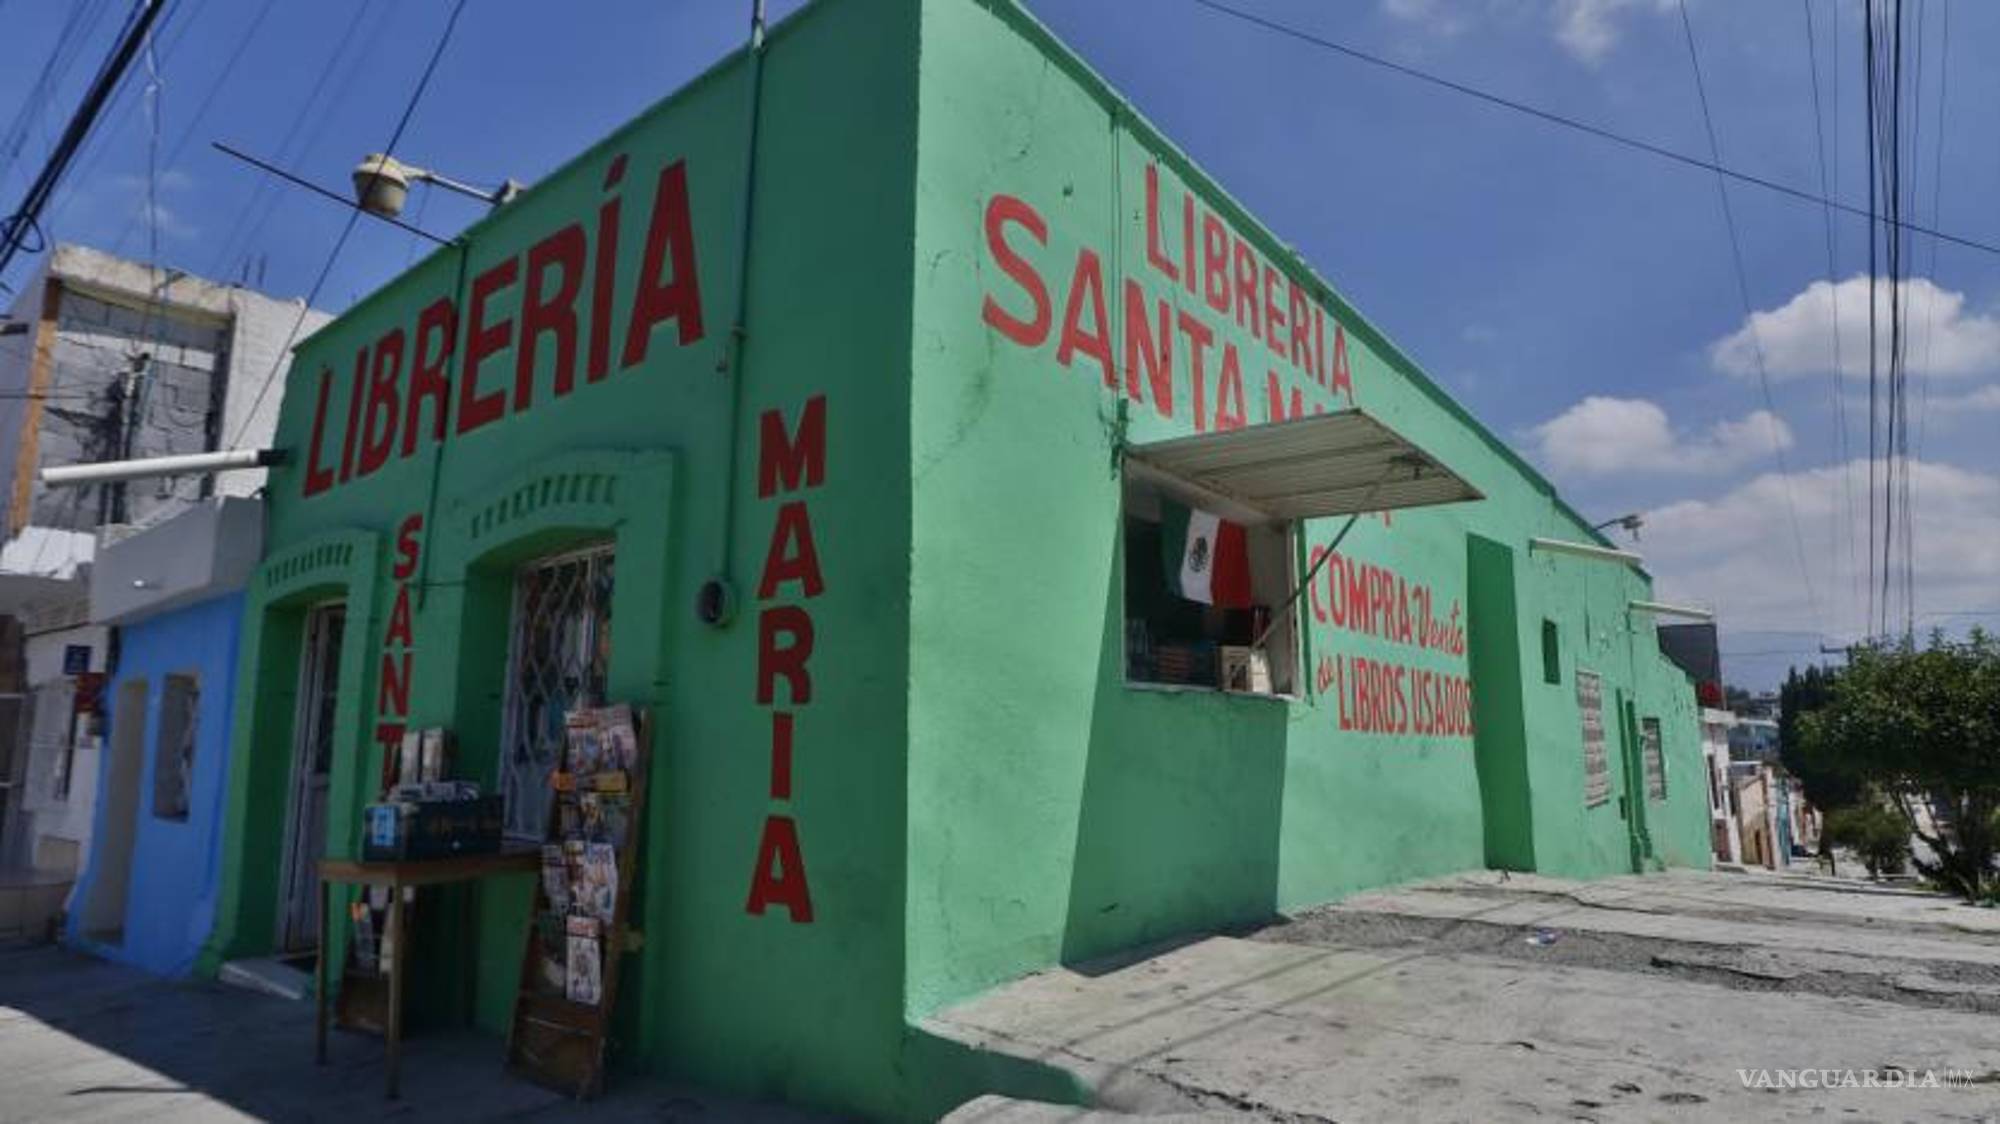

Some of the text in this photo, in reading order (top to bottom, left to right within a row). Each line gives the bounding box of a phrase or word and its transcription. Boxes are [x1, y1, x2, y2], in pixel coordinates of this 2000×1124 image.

[303, 154, 705, 498] LIBRERÍA
[982, 194, 1248, 434] SANTA
[1145, 162, 1354, 404] LIBRERIA
[376, 513, 424, 798] SANT
[746, 395, 827, 923] MARIA
[1336, 653, 1409, 735] LIBROS
[1411, 666, 1476, 737] USADOS
